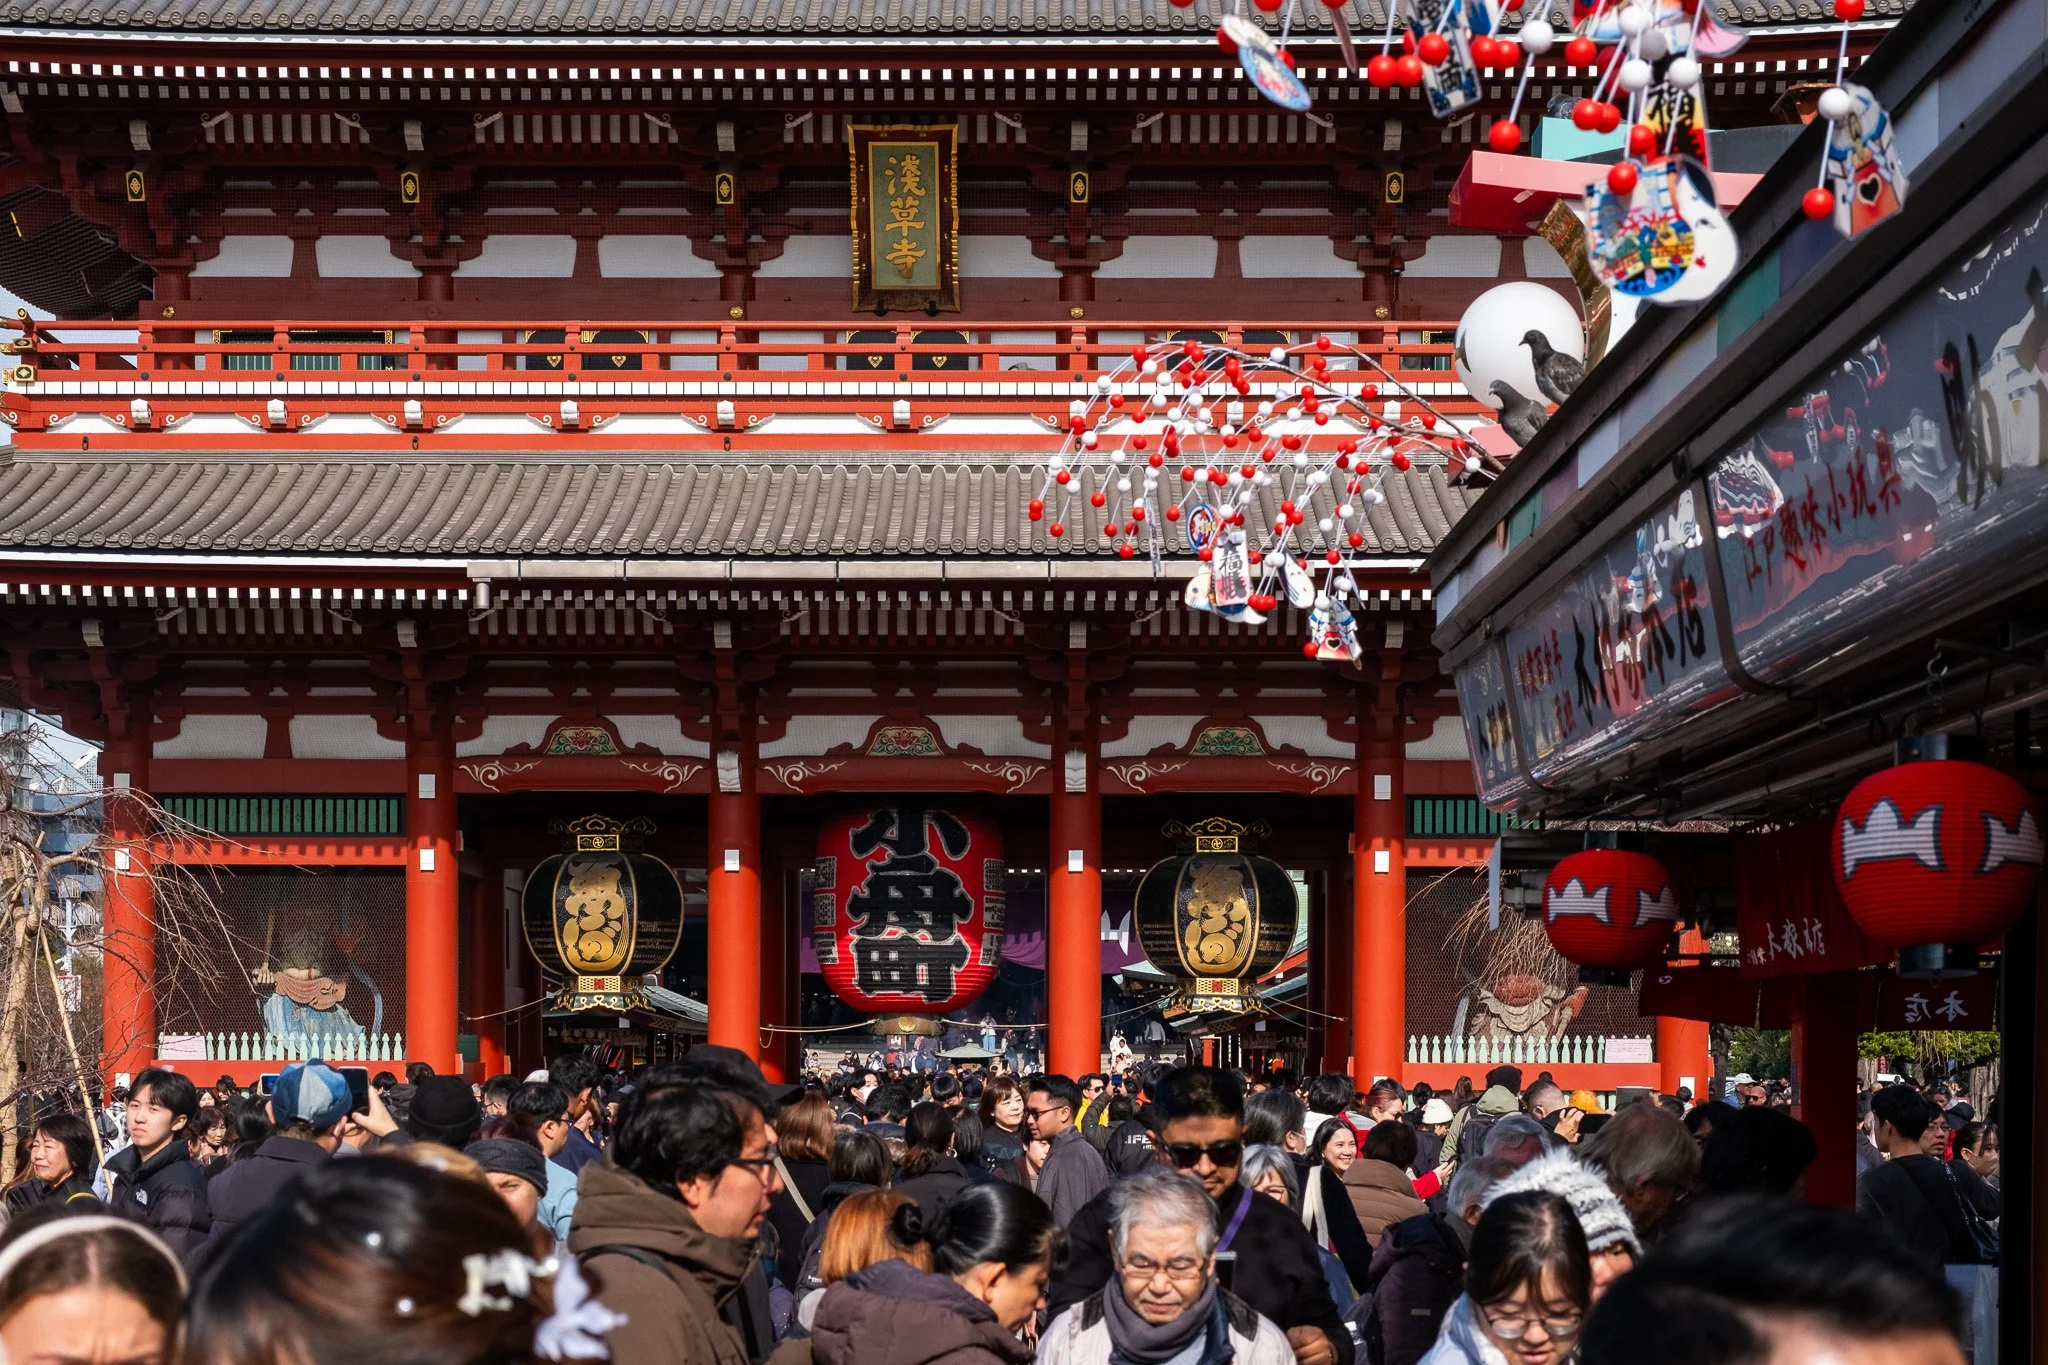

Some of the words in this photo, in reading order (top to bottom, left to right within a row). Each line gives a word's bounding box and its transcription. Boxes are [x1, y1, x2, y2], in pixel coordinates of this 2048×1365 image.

[847, 809, 974, 1003] 小舟町
[1124, 1134, 1152, 1145] IFE
